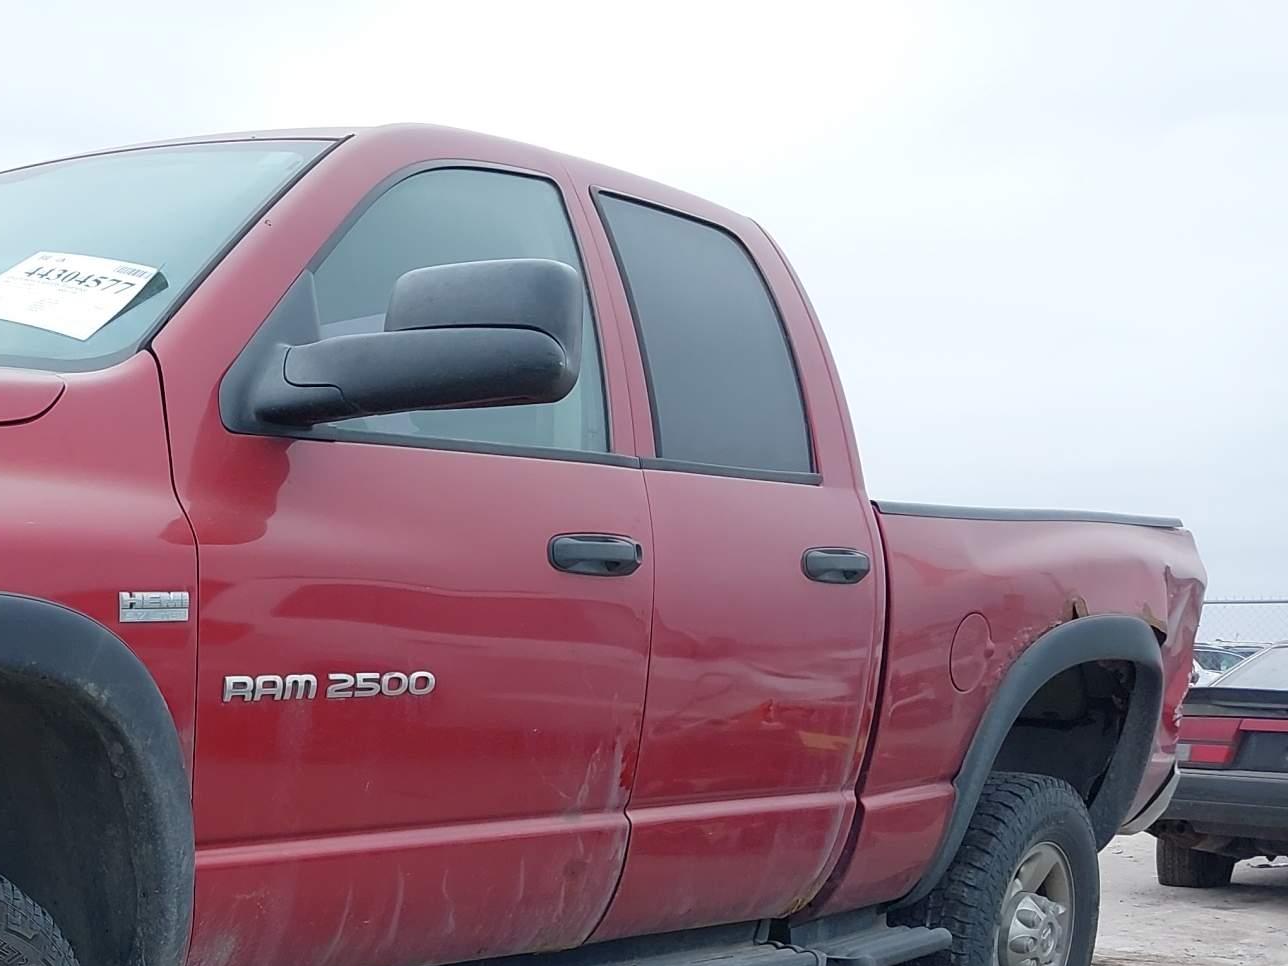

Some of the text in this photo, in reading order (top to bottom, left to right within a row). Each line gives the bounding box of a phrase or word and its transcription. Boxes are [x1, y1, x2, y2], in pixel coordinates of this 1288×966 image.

[24, 266, 136, 295] 44304577
[119, 591, 190, 609] HEMI
[222, 671, 436, 703] RAM 2500
